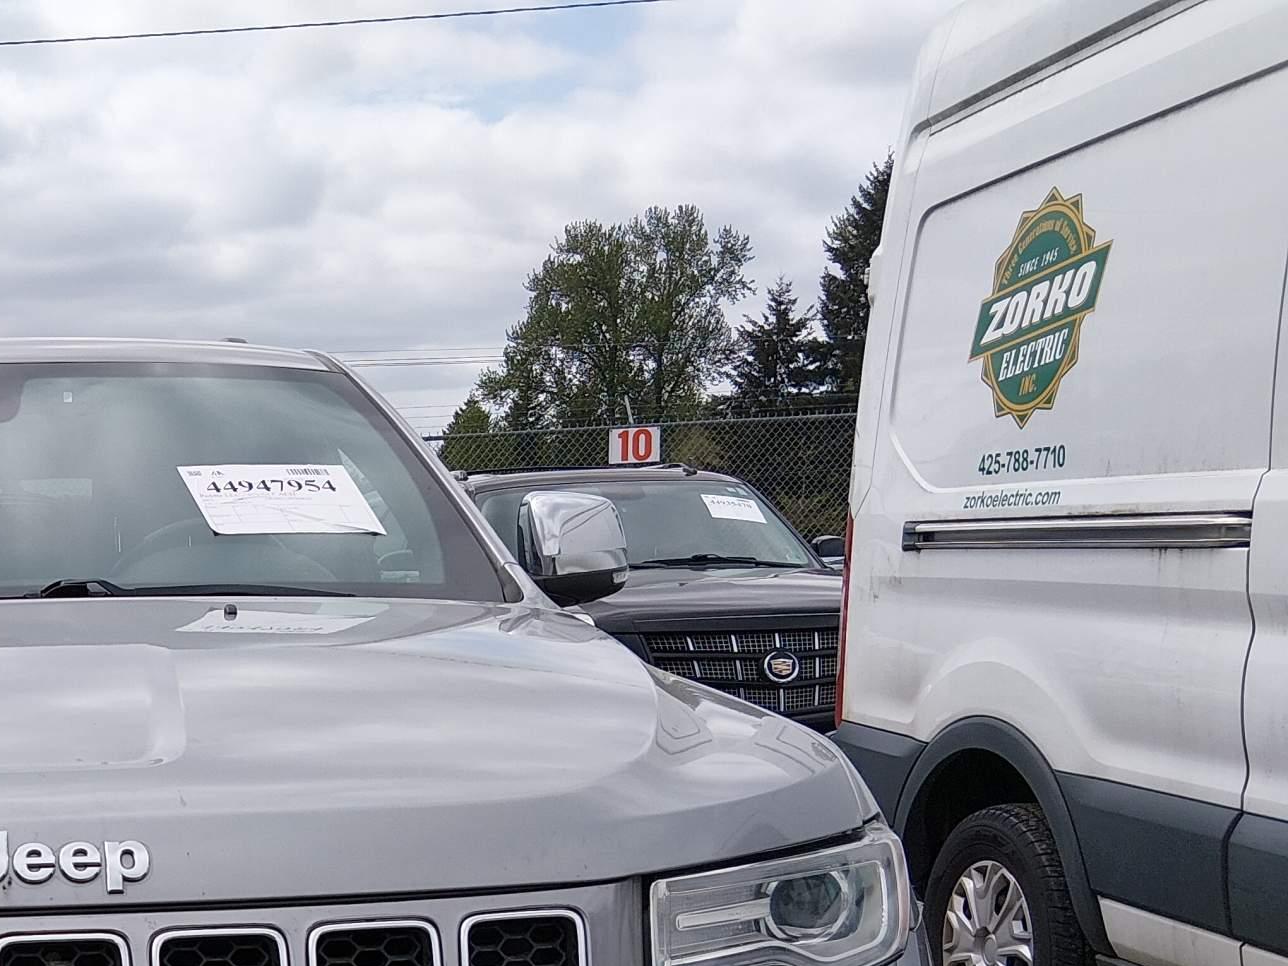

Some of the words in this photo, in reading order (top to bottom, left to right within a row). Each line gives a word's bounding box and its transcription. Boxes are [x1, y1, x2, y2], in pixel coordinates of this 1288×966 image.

[1018, 257, 1039, 277] SINCE
[1041, 247, 1059, 266] 1945
[980, 260, 1097, 345] ZORKO
[998, 328, 1069, 381] ELECTRIC
[1019, 374, 1037, 396] INC.
[617, 428, 652, 461] 10
[978, 445, 1066, 475] 425-788-7710
[207, 479, 337, 492] 44947954
[963, 488, 1061, 509] zorkoelectric.com
